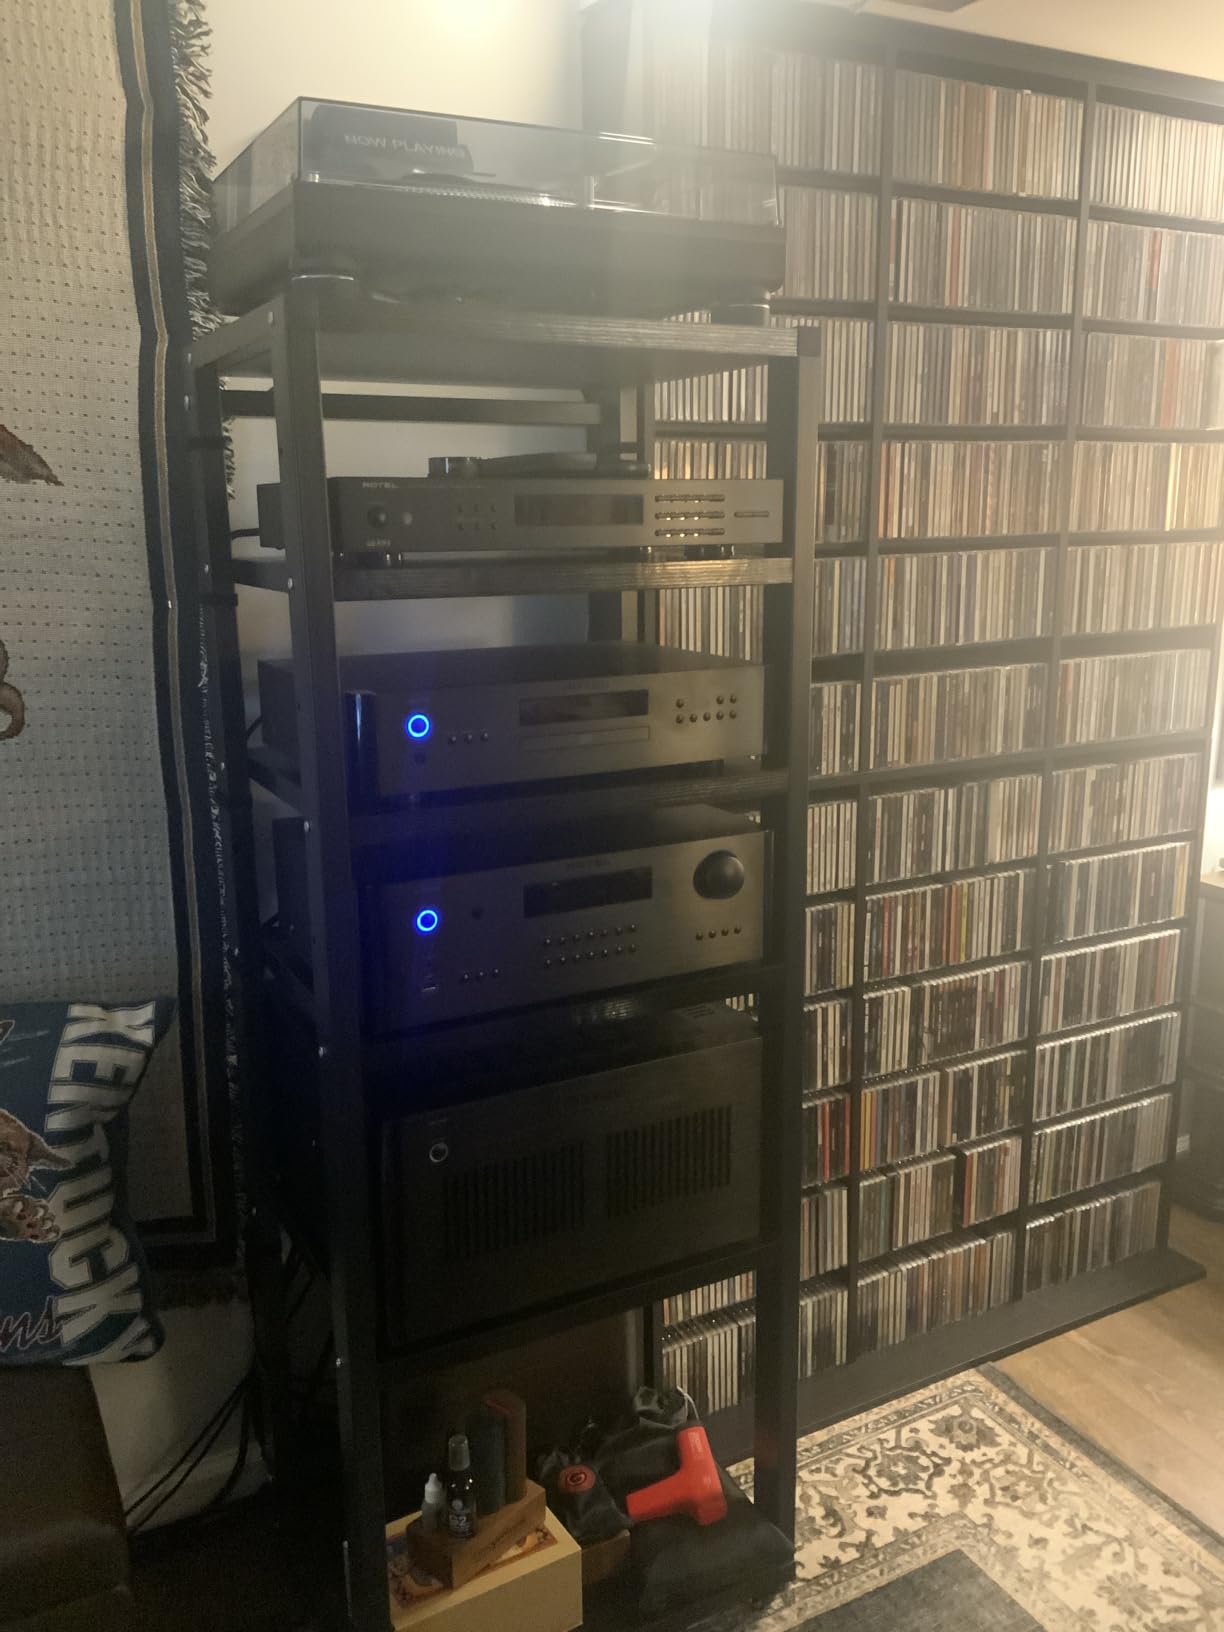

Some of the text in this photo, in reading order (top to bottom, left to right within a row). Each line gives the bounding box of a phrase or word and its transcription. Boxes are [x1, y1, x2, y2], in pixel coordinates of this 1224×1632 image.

[344, 134, 466, 159] NOW PLAYING
[44, 1001, 158, 1366] KENTUCKY
